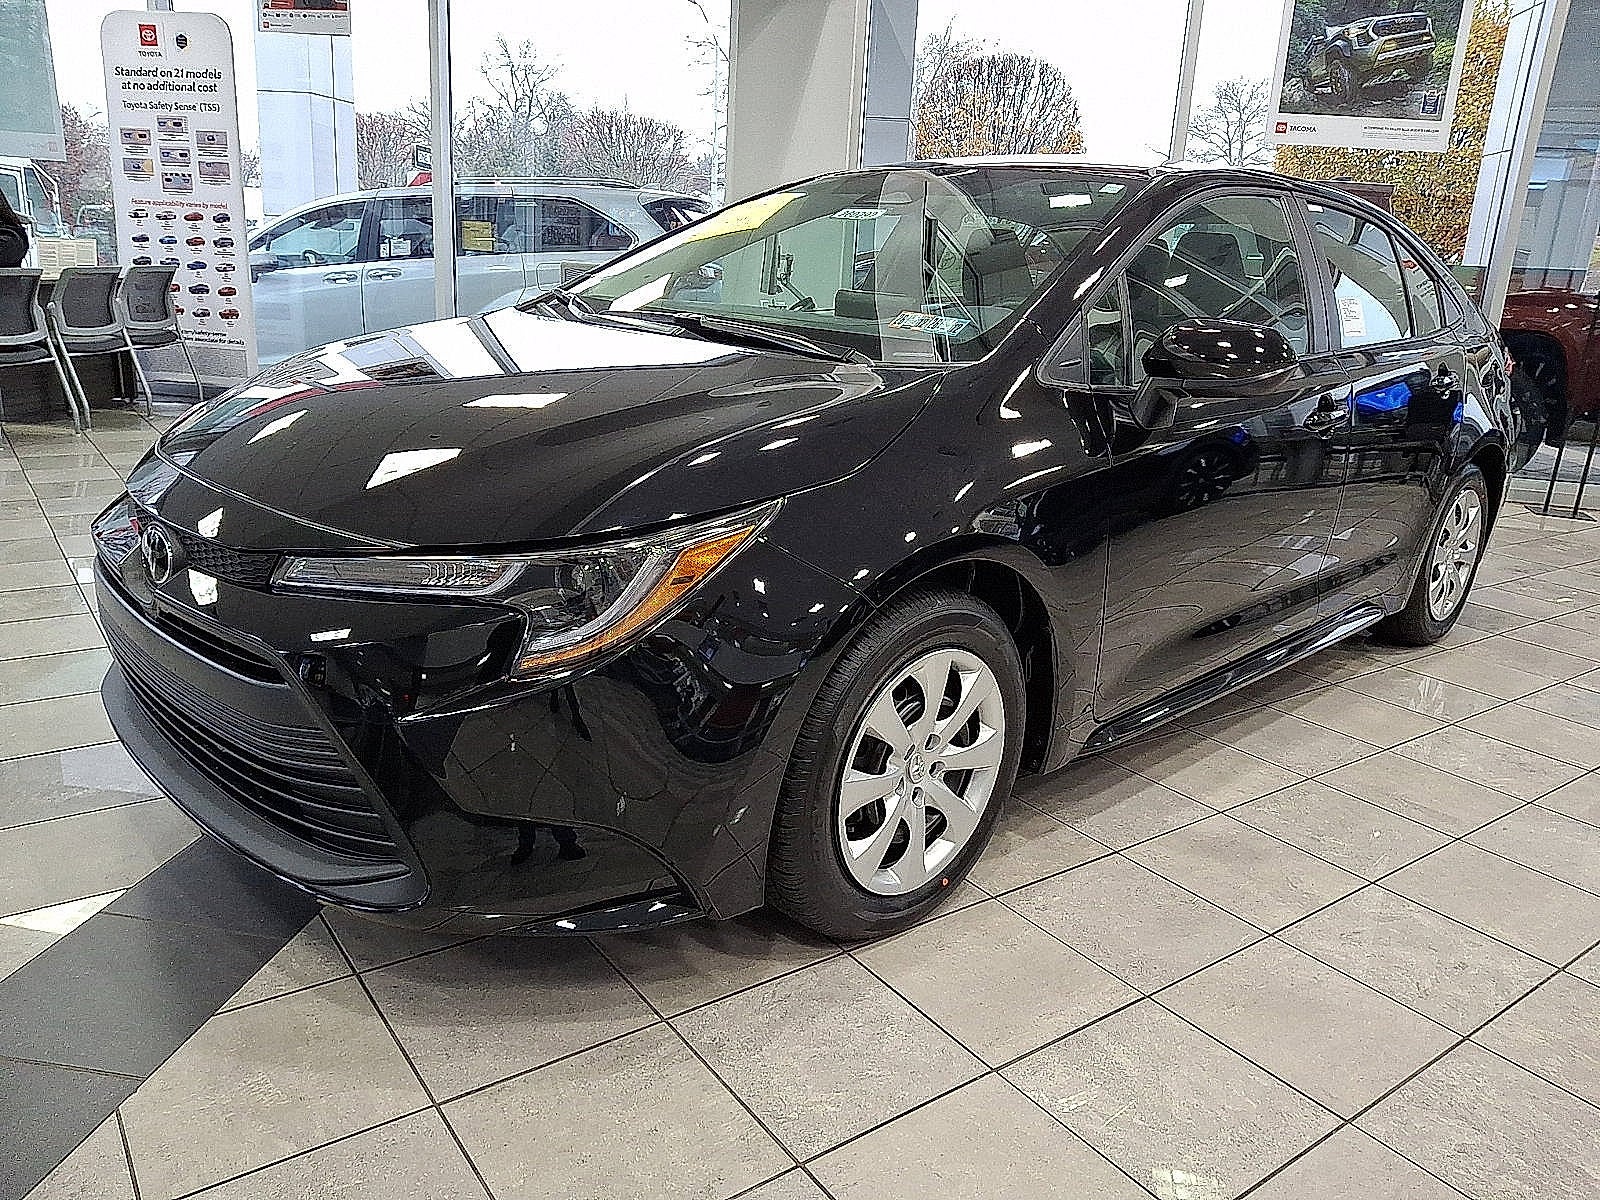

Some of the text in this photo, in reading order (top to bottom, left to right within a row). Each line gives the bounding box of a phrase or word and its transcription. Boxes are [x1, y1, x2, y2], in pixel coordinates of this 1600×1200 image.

[114, 66, 222, 79] Standard on 21 models
[122, 81, 218, 92] at no additional cost
[122, 100, 147, 110] Toyota
[149, 101, 173, 112] Safety
[200, 103, 220, 112] (TSS)
[1289, 125, 1317, 133] TACOMA
